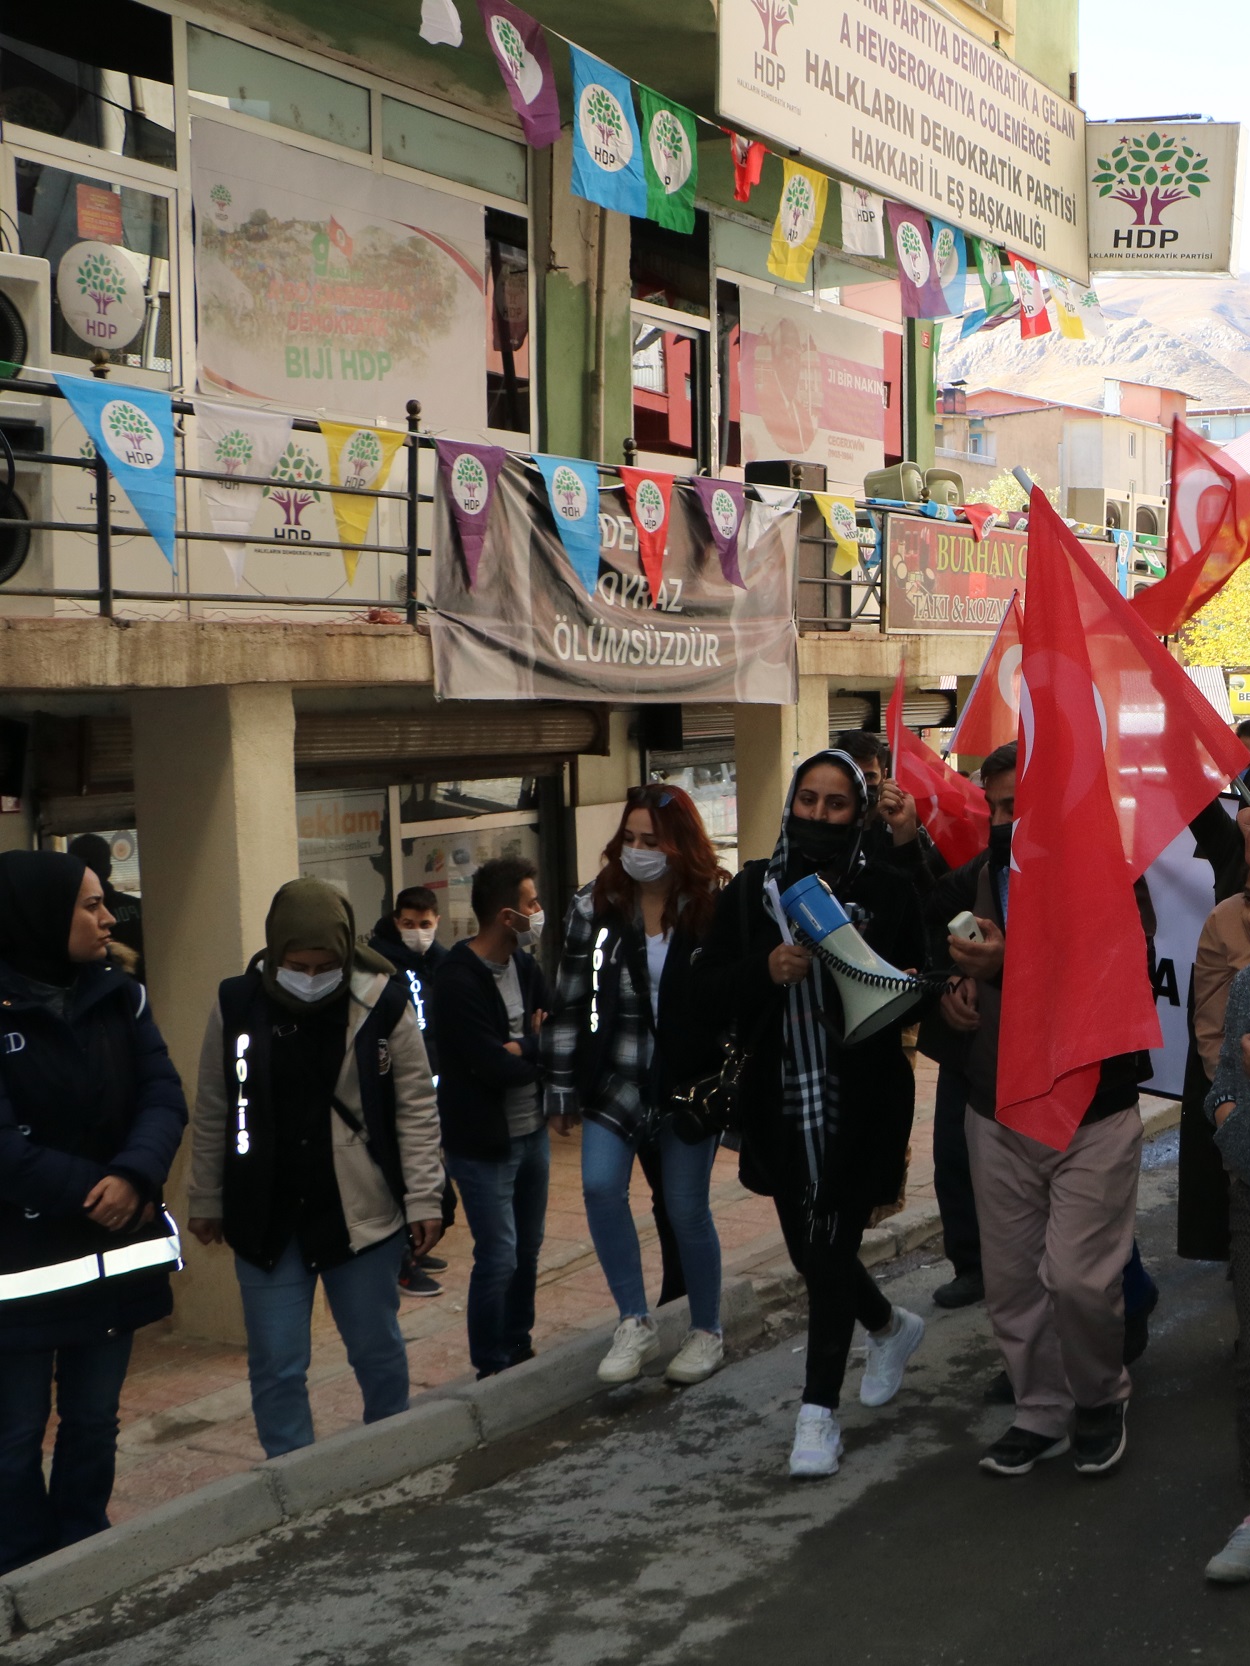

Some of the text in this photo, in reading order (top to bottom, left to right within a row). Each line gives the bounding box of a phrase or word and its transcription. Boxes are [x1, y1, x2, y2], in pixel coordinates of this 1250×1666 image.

[754, 51, 786, 90] HDP
[893, 0, 1075, 141] PARTIYA DEMOKRATÎK A GELAN
[840, 12, 1051, 166] A HEVSEROKATIYA COLEMÊRGÊ
[806, 48, 1077, 226] HALKLARIN DEMOKRATİK PARTİSİ
[594, 146, 615, 168] HDP
[852, 126, 1046, 251] HAKKARİ İL EŞ BAŞKANLIĞI
[857, 210, 876, 223] HDP
[1113, 229, 1179, 249] HDP
[1125, 252, 1178, 260] DEMOKRATİK
[1180, 252, 1213, 260] PARTİSİ
[86, 319, 118, 339] HDP
[340, 349, 392, 381] HDP
[125, 450, 154, 466] HDP
[463, 498, 480, 511] HDP
[936, 533, 1014, 578] BURHAN
[587, 571, 683, 612] OYRAZ
[913, 594, 1012, 623] TAKI & KOZM
[553, 614, 721, 667] ÖLÜMSÜZDÜR
